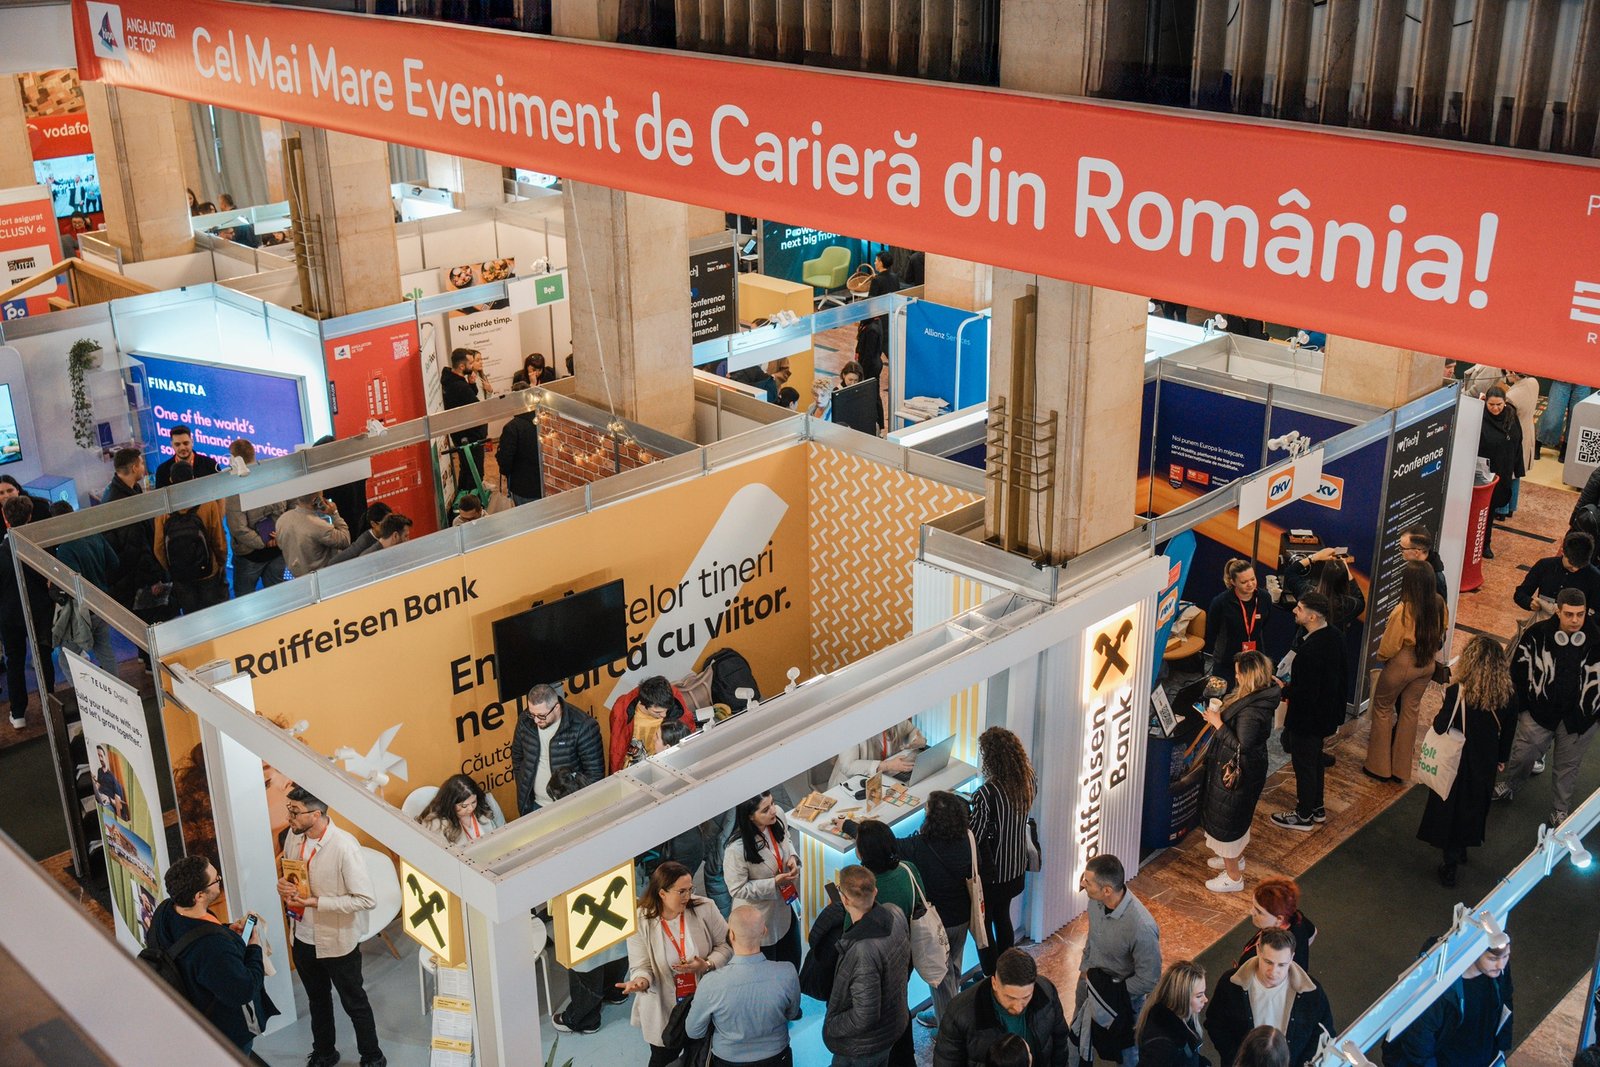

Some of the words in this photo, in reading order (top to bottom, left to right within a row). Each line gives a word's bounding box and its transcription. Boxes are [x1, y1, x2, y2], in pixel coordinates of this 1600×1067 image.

[126, 17, 175, 39] ANGAJATORI
[127, 35, 140, 51] DE
[139, 37, 156, 53] TOP
[192, 26, 242, 84] Cel
[245, 33, 302, 96] Mai
[307, 43, 394, 112] Mare
[402, 57, 621, 154] Eveniment
[634, 91, 694, 167] de
[710, 103, 921, 208] Carieră
[943, 136, 1046, 231] din
[1074, 155, 1499, 310] România!
[14, 213, 43, 225] asigurat
[0, 225, 34, 239] CLUSIV
[36, 225, 46, 233] de
[781, 237, 801, 250] next
[802, 233, 817, 245] big
[543, 285, 556, 294] Bolt
[700, 305, 726, 318] passion
[469, 319, 493, 331] pierde
[493, 316, 513, 325] timp.
[693, 323, 720, 337] rmance!
[694, 318, 708, 327] into
[924, 327, 946, 339] Allianz
[946, 332, 971, 346] Serces
[147, 376, 207, 397] FINASTRA
[153, 405, 179, 421] One
[180, 409, 193, 424] of
[193, 411, 212, 428] the
[213, 416, 256, 434] world's
[253, 442, 289, 457] ervices
[1171, 434, 1182, 442] Noi
[1181, 438, 1200, 448] punem
[1199, 441, 1219, 453] Europa
[1270, 478, 1291, 498] DKV
[1316, 484, 1338, 497] KV
[1472, 508, 1484, 565] STRONGER
[623, 579, 690, 629] elor
[697, 540, 774, 600] tineri
[234, 607, 399, 680] Raiffeisen
[403, 575, 480, 623] Bank
[455, 701, 505, 744] ne
[657, 621, 697, 659] cu
[703, 585, 792, 640] viitor.
[91, 676, 112, 695] TELUS
[101, 705, 120, 723] future
[1109, 688, 1133, 790] Bank
[1421, 742, 1438, 759] Bolt
[1418, 757, 1439, 776] Food
[1079, 704, 1107, 891] aiffeisen
